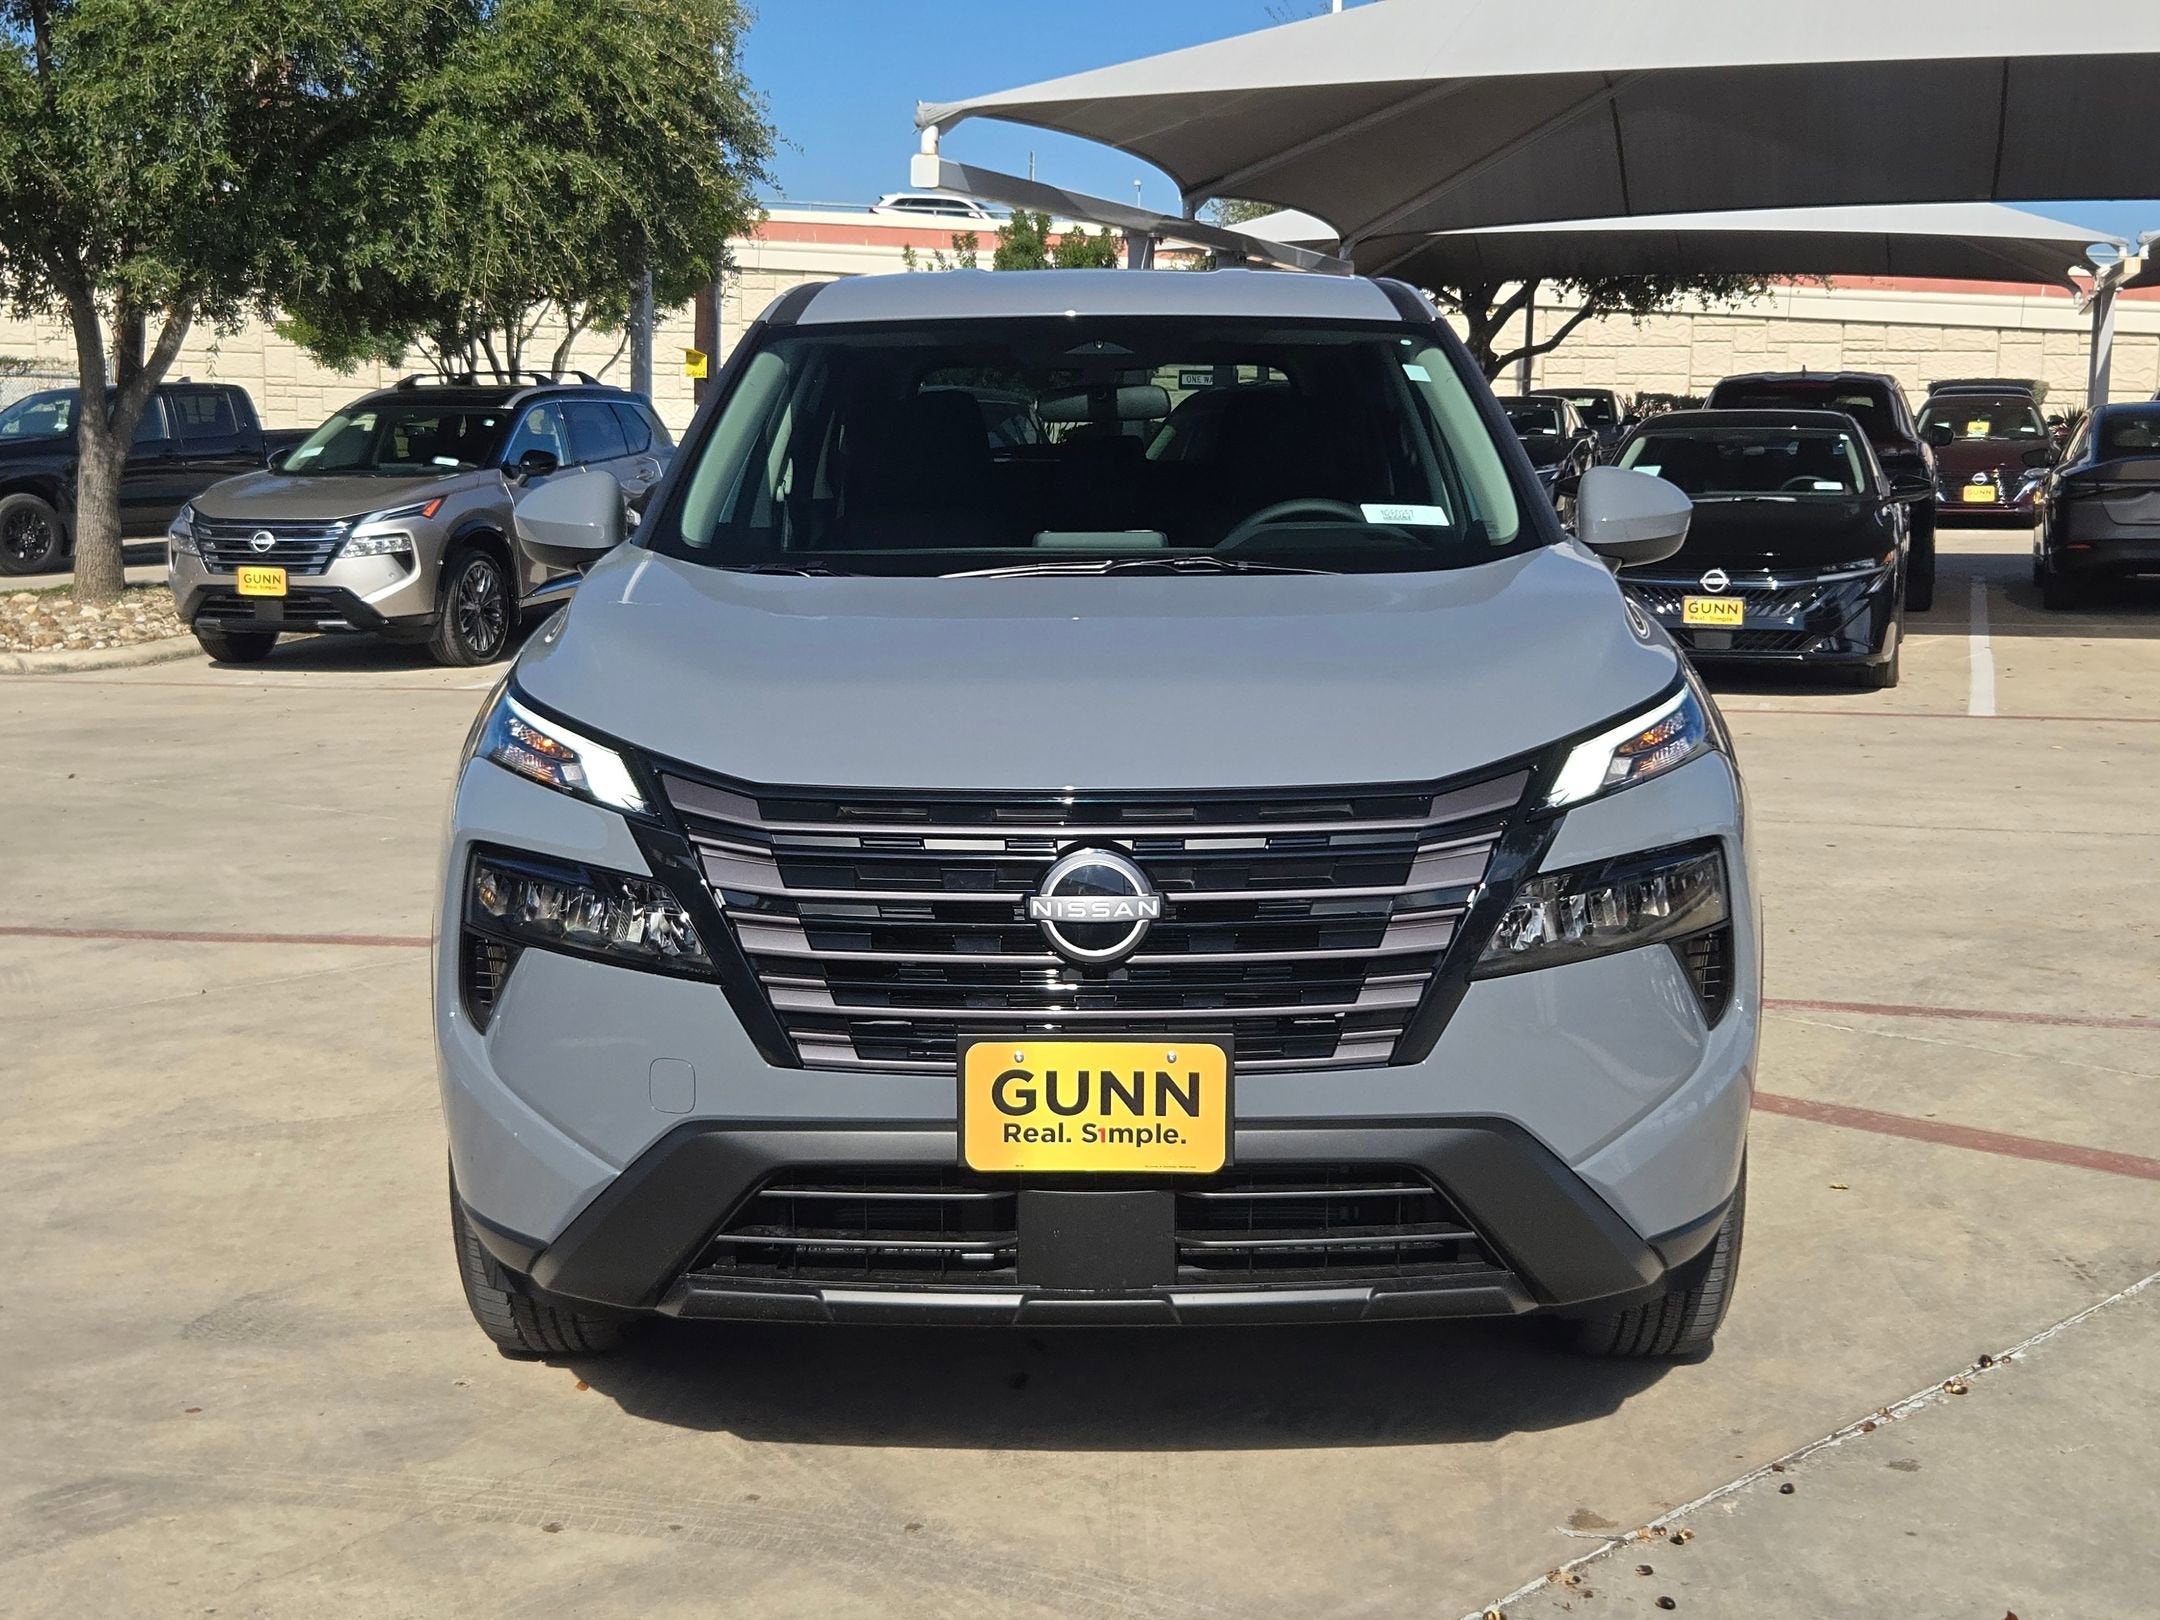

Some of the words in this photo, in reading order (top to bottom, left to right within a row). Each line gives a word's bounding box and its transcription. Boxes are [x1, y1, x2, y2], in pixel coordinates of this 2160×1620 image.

[1186, 375, 1201, 384] ONE
[243, 573, 282, 585] GUNN
[1688, 602, 1738, 615] GUNN
[1032, 900, 1158, 918] NISSAN
[991, 1068, 1200, 1118] GUNN
[1003, 1122, 1072, 1143] Real.
